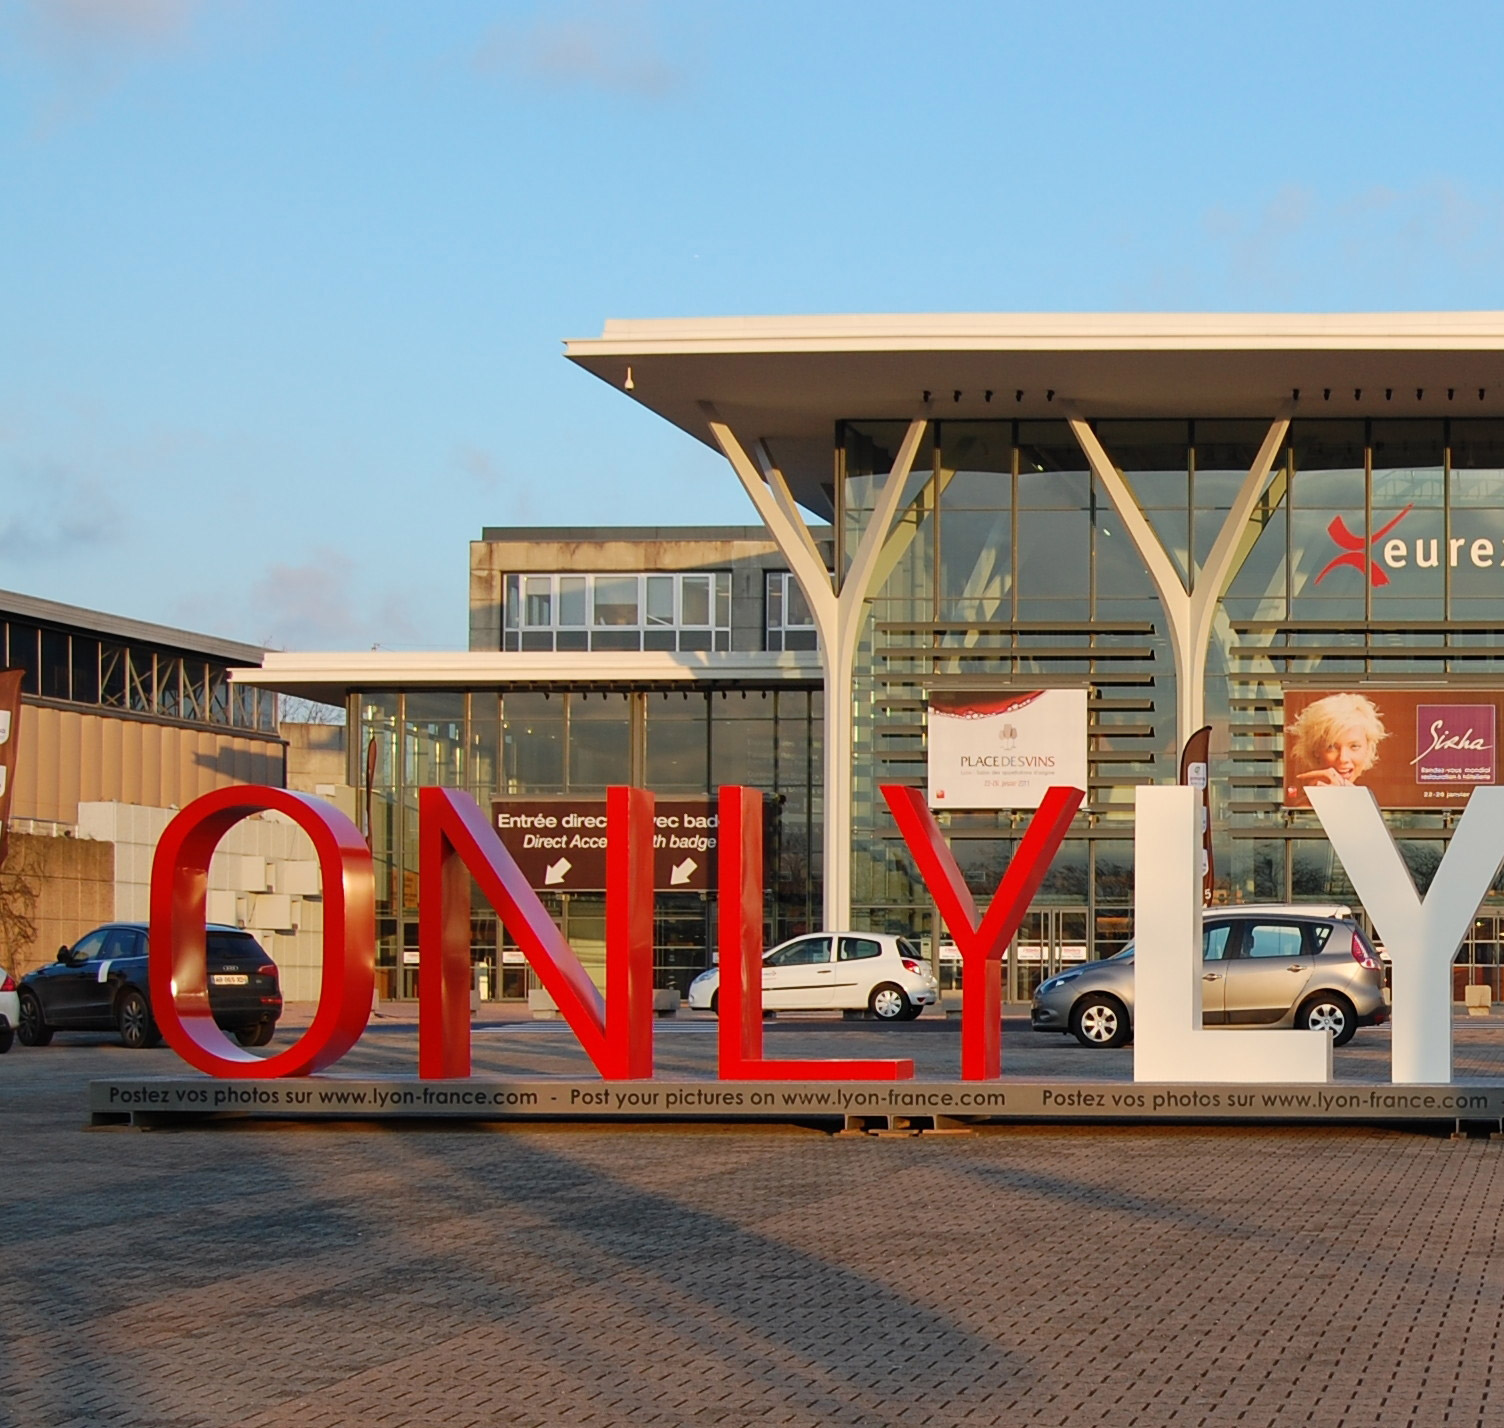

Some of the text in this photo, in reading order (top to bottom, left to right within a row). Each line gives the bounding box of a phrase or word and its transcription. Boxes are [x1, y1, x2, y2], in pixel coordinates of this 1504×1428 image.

[498, 813, 557, 828] Entrée
[562, 813, 608, 828] direc
[684, 813, 721, 829] bad
[523, 834, 568, 849] Direct
[570, 834, 608, 849] Acce
[669, 833, 717, 851] badge
[110, 1087, 170, 1103] Postez
[176, 1091, 207, 1103] vos
[215, 1086, 279, 1108] photos
[285, 1091, 313, 1104] sur
[319, 1087, 538, 1109] www.lyon-france.com
[571, 1089, 609, 1105] Post
[616, 1092, 659, 1111] your
[665, 1089, 744, 1111] pictures
[750, 1092, 775, 1106] on
[782, 1089, 1006, 1111] www.lyon-france.com
[1043, 1090, 1105, 1107] Postez
[1112, 1094, 1145, 1107] vos
[1153, 1090, 1221, 1112] photos
[1228, 1094, 1255, 1108] sur
[1261, 1091, 1487, 1112] www.lyon-france.com
